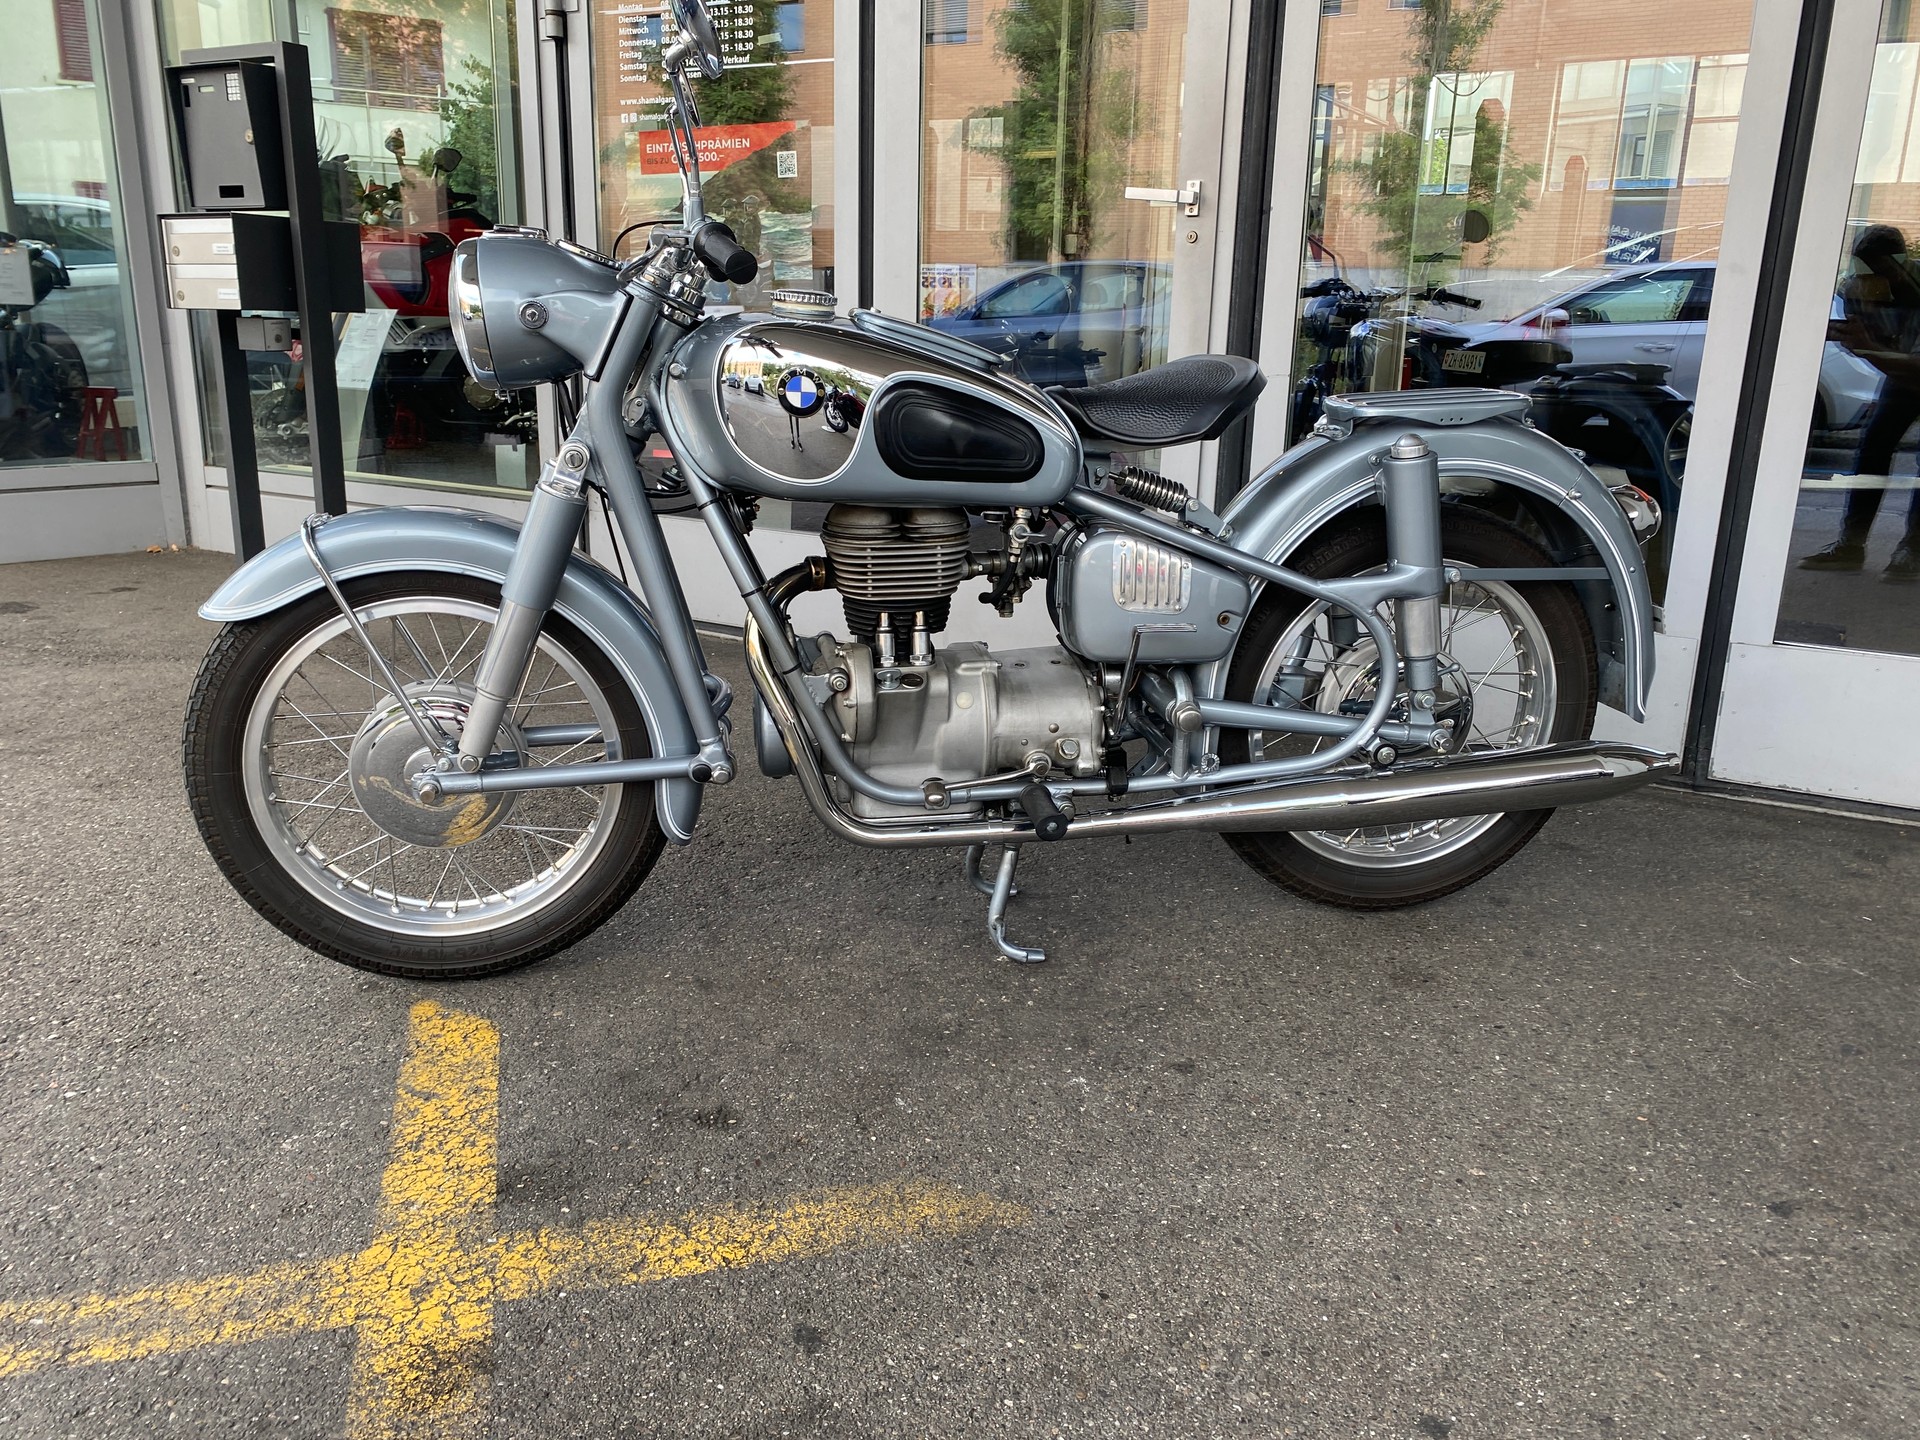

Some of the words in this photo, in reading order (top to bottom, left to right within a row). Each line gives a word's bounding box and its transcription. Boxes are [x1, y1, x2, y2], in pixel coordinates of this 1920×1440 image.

[618, 3, 643, 12] Montag
[618, 15, 648, 24] Dienstag
[710, 7, 729, 16] 13.15
[734, 5, 754, 14] 18.30
[618, 26, 649, 35] Mittwoch
[714, 19, 729, 28] 3.15
[734, 17, 754, 27] 18.30
[618, 39, 657, 48] Donnerstag
[734, 30, 754, 39] 18.30
[619, 51, 643, 60] Freitag
[734, 42, 754, 51] 18.30
[619, 62, 648, 71] Samstag
[723, 54, 750, 65] Verkauf
[620, 74, 647, 83] Sonntag
[646, 137, 750, 154] EINTASHPRÄMIEN
[647, 157, 659, 165] BIS
[660, 156, 669, 164] ZU
[783, 367, 823, 384] BMW
